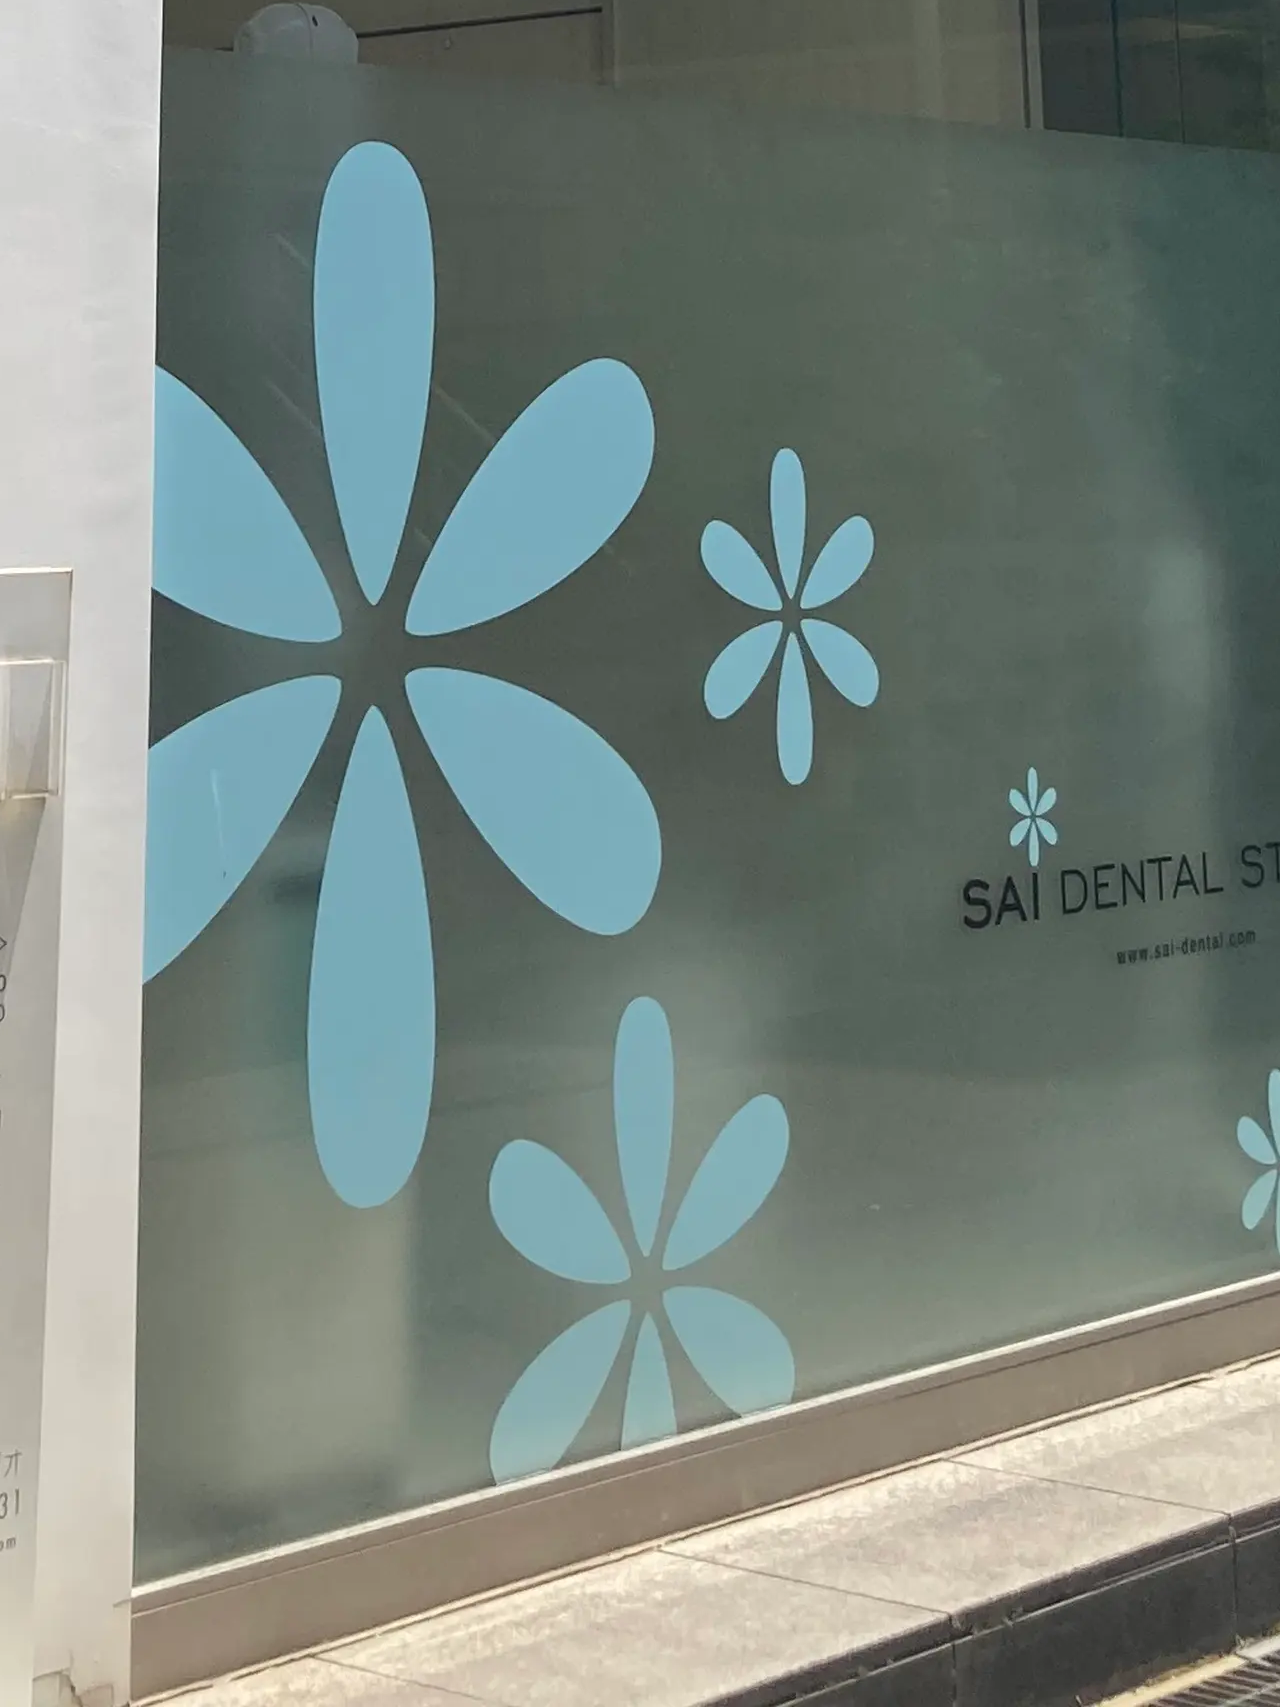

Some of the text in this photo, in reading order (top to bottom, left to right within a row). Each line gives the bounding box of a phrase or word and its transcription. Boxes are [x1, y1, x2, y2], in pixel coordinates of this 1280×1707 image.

[962, 872, 1041, 929] SAI
[1060, 852, 1224, 915] DENTAL
[1116, 928, 1256, 965] www.sai-dental.com
